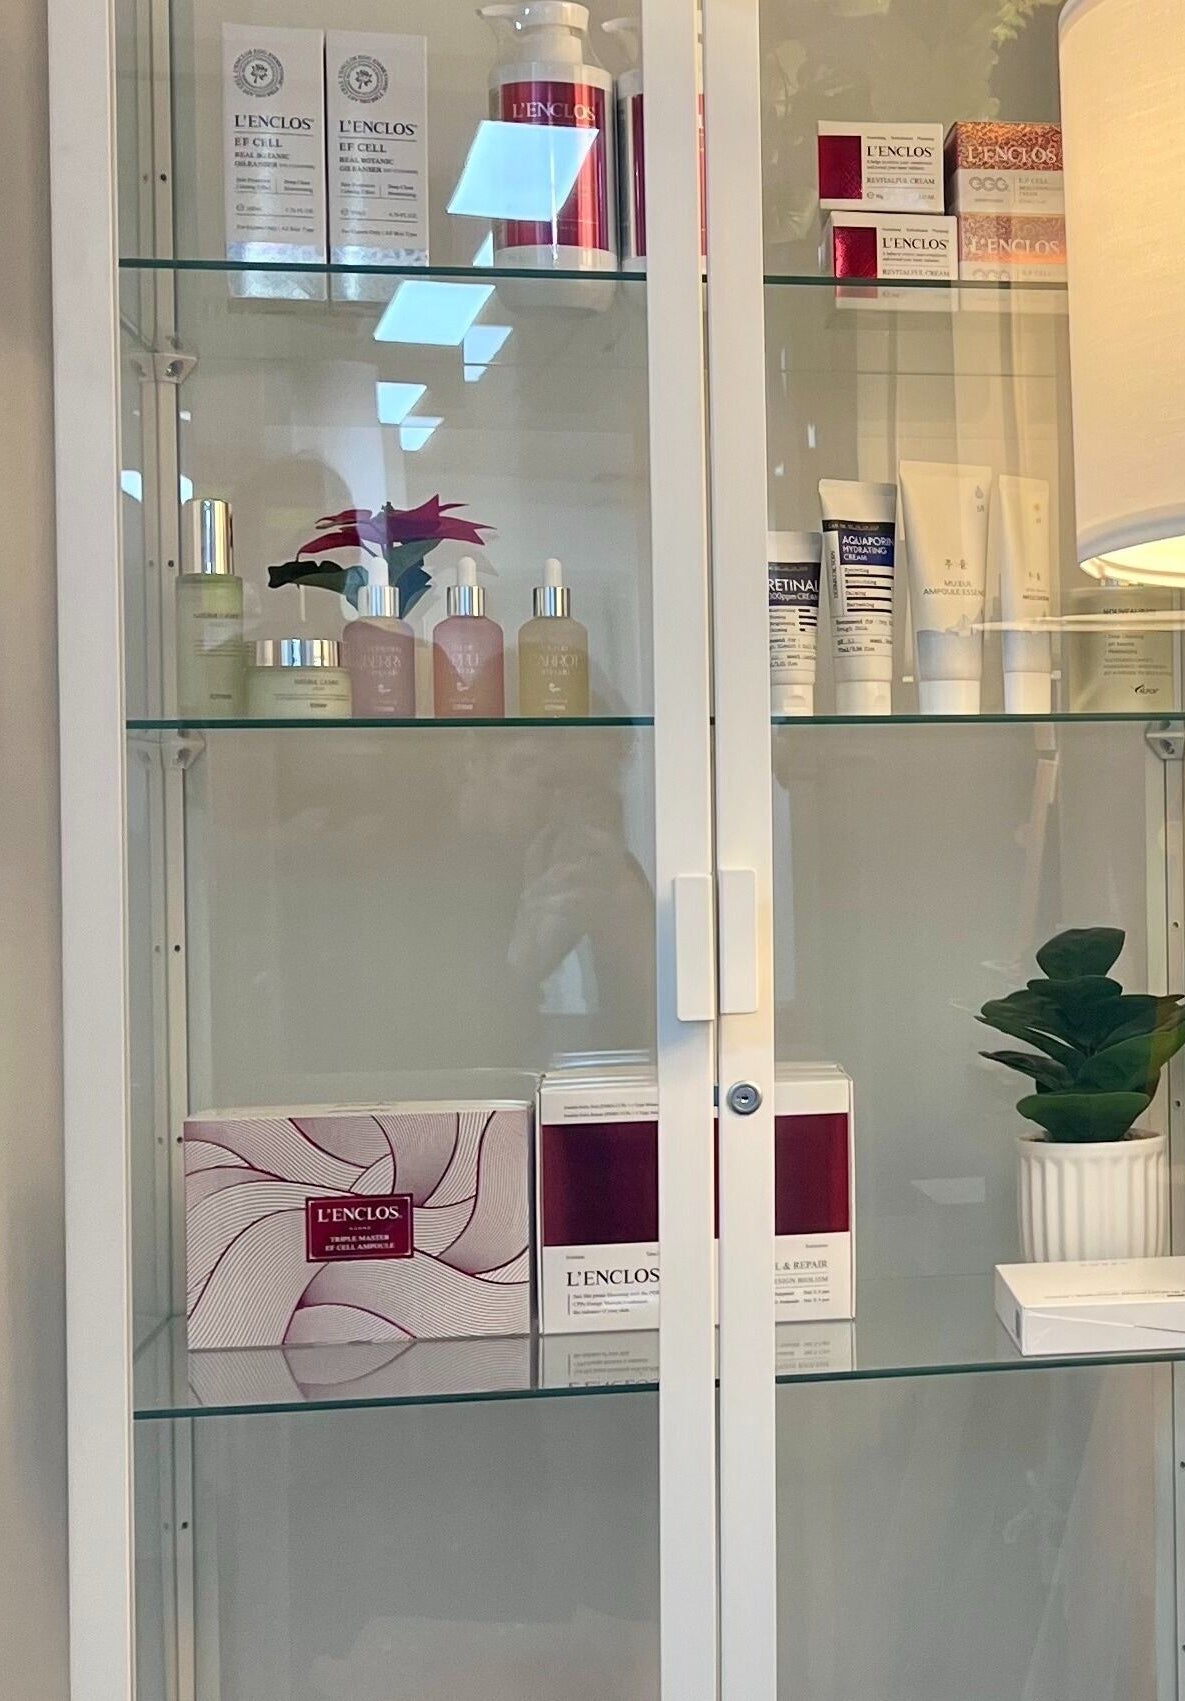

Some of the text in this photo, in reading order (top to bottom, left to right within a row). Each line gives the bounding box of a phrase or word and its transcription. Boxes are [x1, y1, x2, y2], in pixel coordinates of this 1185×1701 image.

[512, 102, 596, 120] L'ENCLOS
[234, 114, 313, 130] L'ENCLOS
[339, 120, 416, 136] L'ENCLOS
[339, 142, 388, 153] EF CELL
[866, 145, 932, 158] L'ENCLOS
[967, 145, 1057, 164] L'ENCLOS
[909, 177, 935, 185] CREAM
[882, 237, 947, 250] L'ENCLOS
[970, 237, 1060, 256] L'ENCLOS
[842, 545, 888, 555] HYDRATING
[843, 553, 868, 561] CREAM
[769, 578, 819, 592] RETINAL
[317, 1205, 400, 1223] L'ENCLOS
[793, 1259, 828, 1270] REPAIR
[566, 1267, 660, 1287] L'ENCLOS
